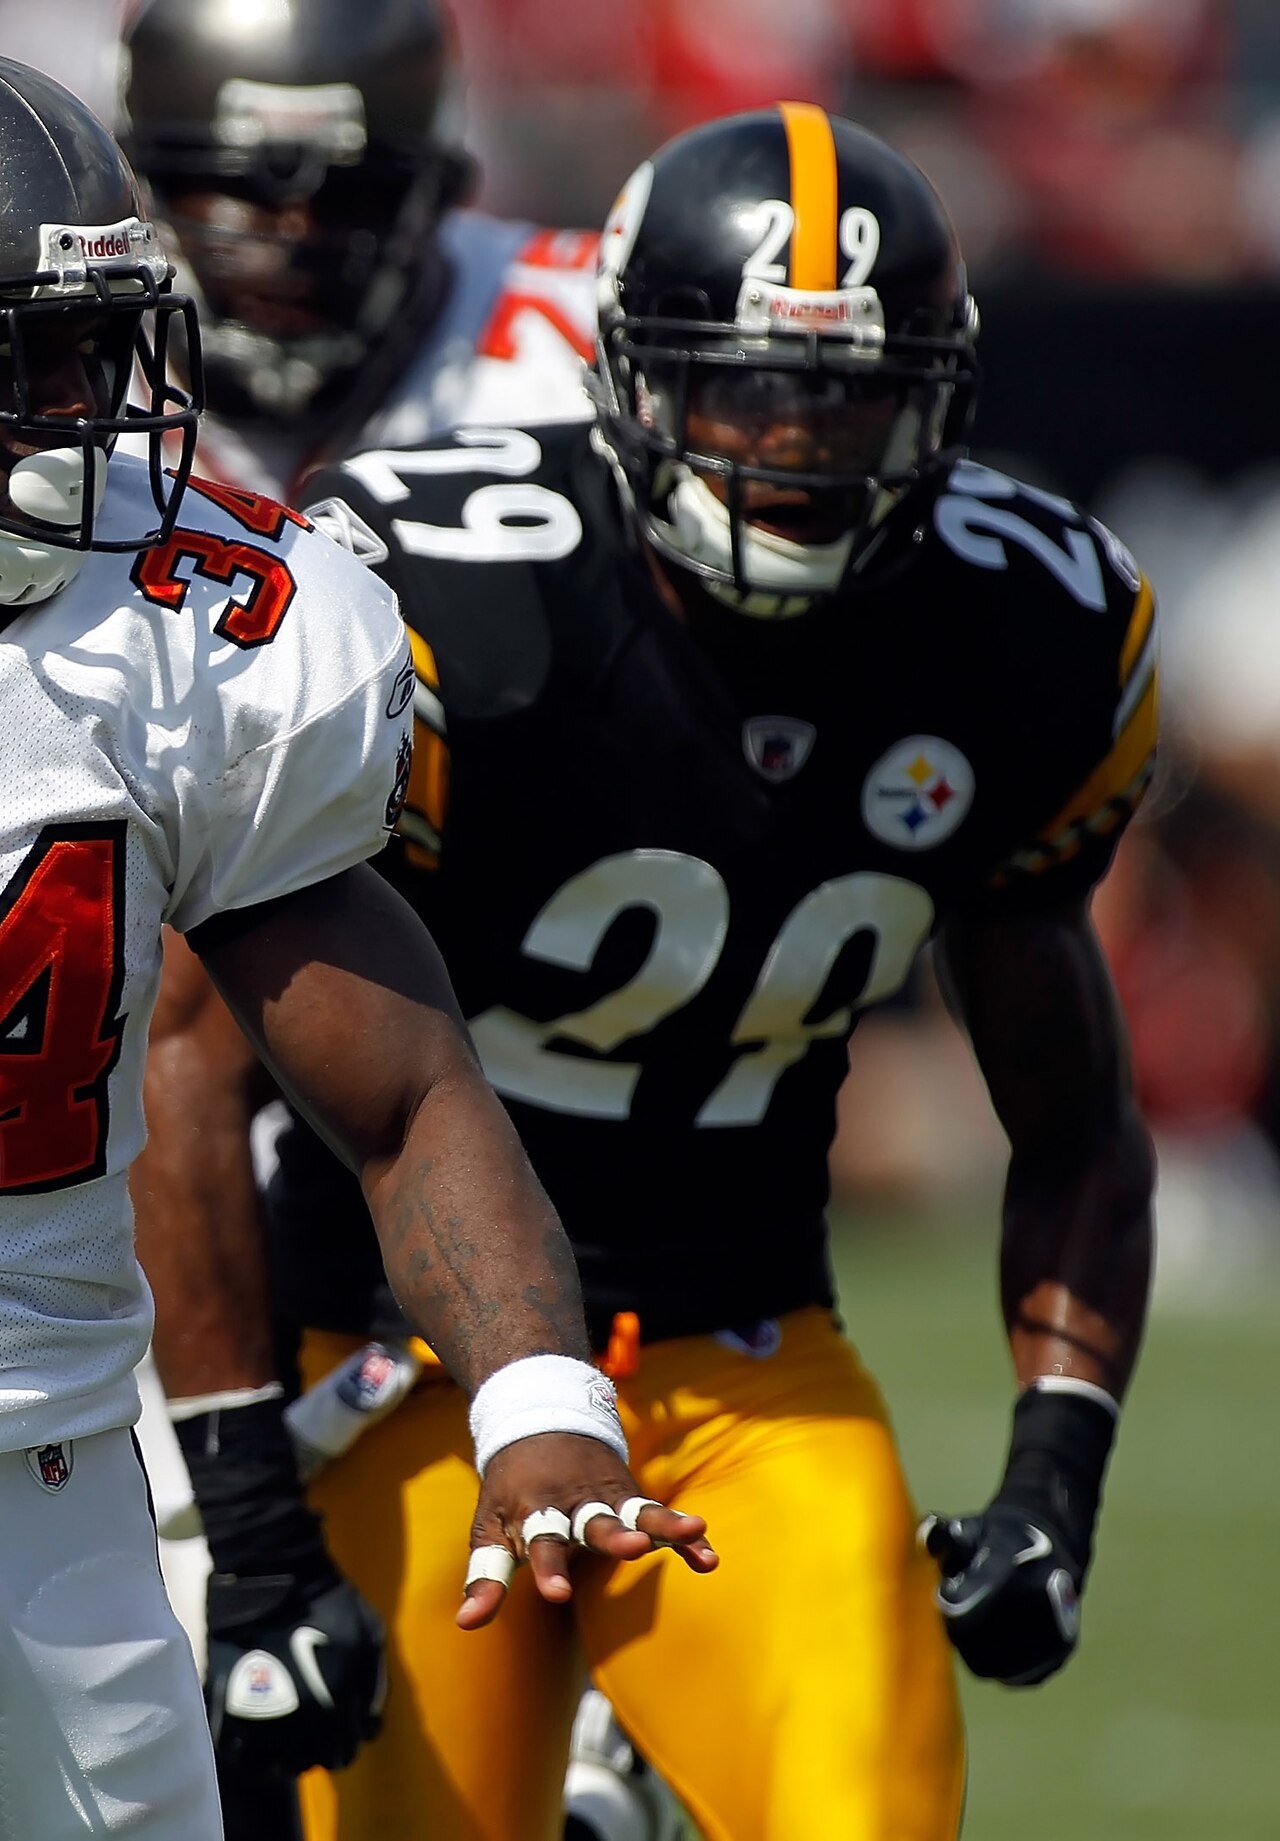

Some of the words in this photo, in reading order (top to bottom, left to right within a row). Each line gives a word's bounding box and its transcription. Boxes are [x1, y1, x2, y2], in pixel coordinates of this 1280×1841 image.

[741, 199, 881, 288] 29
[129, 467, 316, 650] 34
[342, 426, 583, 563] 29
[467, 848, 934, 1128] 29
